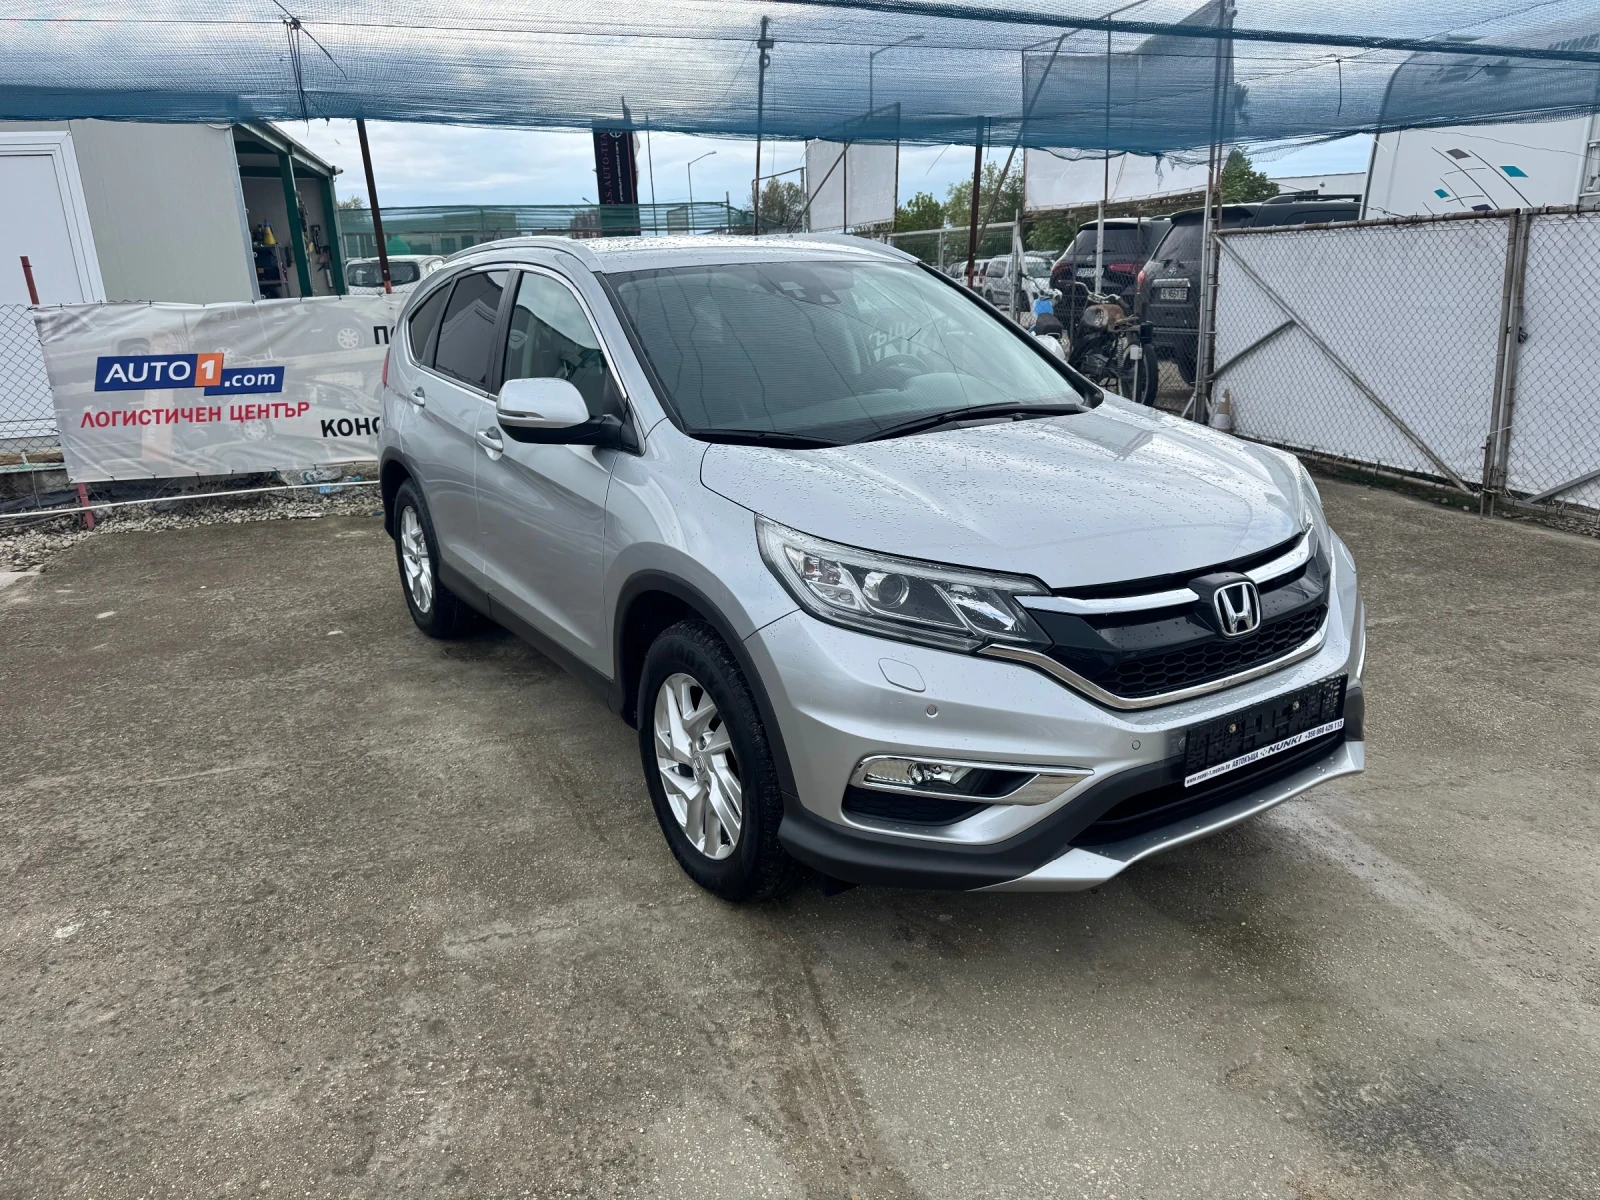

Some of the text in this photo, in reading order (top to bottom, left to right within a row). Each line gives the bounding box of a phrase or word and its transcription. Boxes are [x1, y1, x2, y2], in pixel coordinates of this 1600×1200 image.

[600, 132, 612, 187] AUTO-TEA
[80, 401, 310, 428] ЛОГИСТИЧЕН ЦЕНТЪР
[1268, 735, 1303, 753] NUNKI
